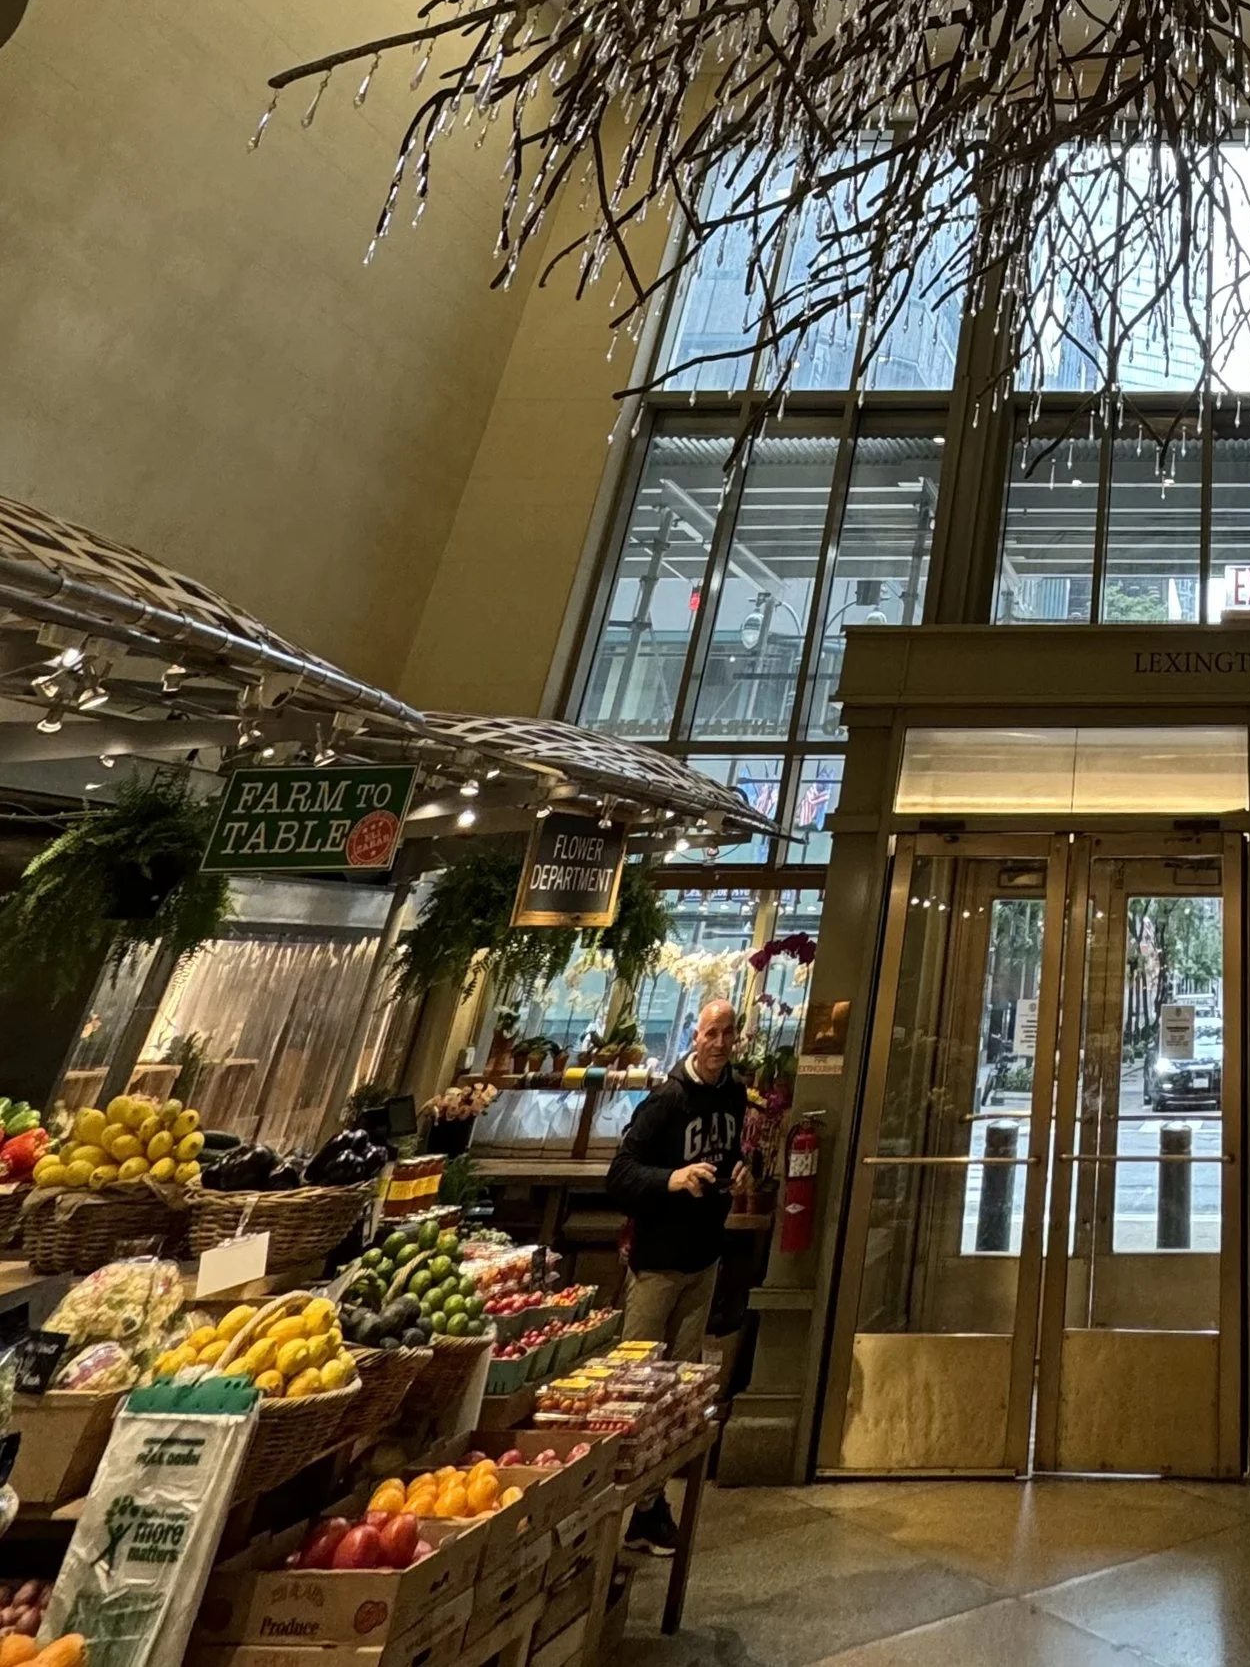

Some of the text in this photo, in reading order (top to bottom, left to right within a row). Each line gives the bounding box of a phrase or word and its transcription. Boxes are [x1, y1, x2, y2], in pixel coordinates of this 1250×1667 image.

[232, 780, 392, 814] FARM TO
[220, 820, 351, 855] TABLE
[553, 834, 604, 861] FLOWER
[530, 864, 613, 892] DEPARTMENT
[684, 1112, 736, 1161] GAP
[133, 1521, 185, 1546] more
[260, 1615, 321, 1637] Produce
